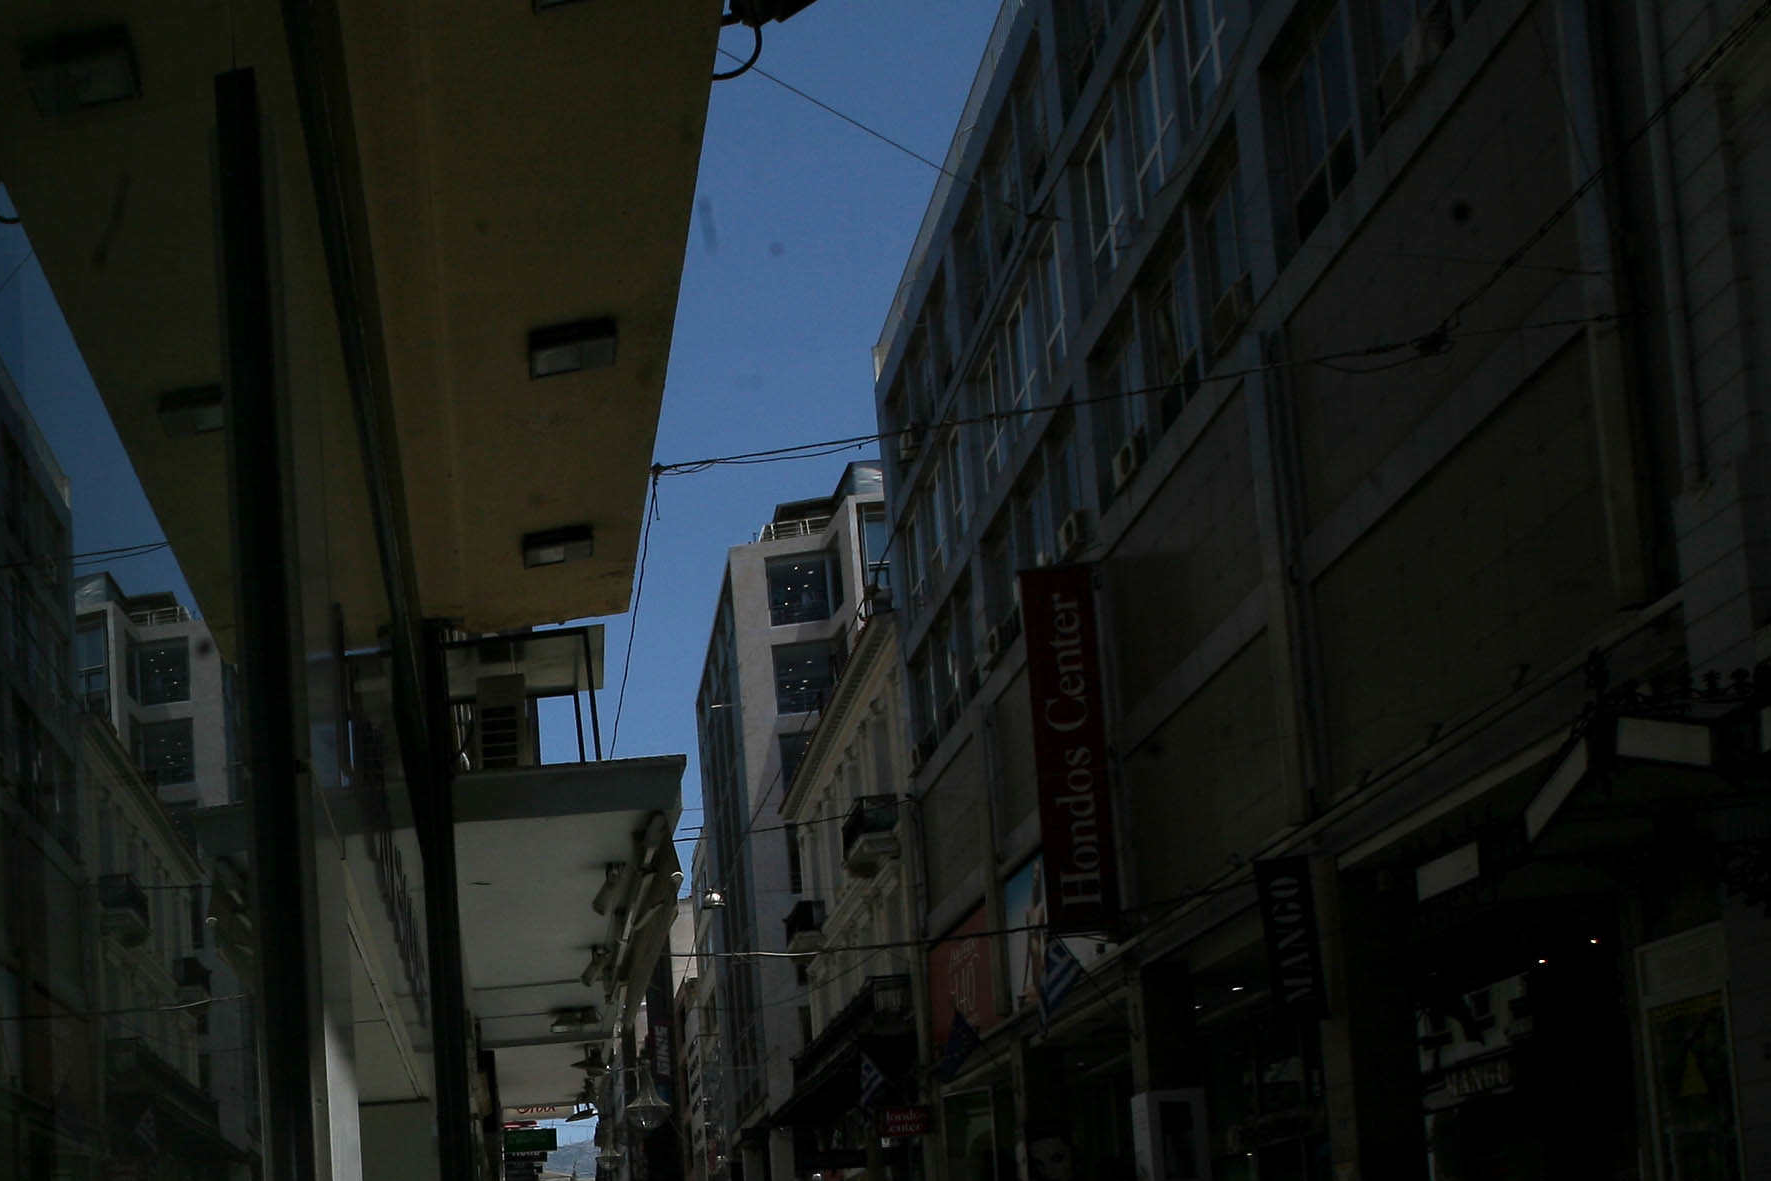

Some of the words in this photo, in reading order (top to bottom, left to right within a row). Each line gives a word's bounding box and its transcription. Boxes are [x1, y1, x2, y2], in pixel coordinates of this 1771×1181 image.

[1044, 592, 1091, 733] Center
[1052, 746, 1103, 909] Hondos
[1267, 873, 1317, 1006] MANGO
